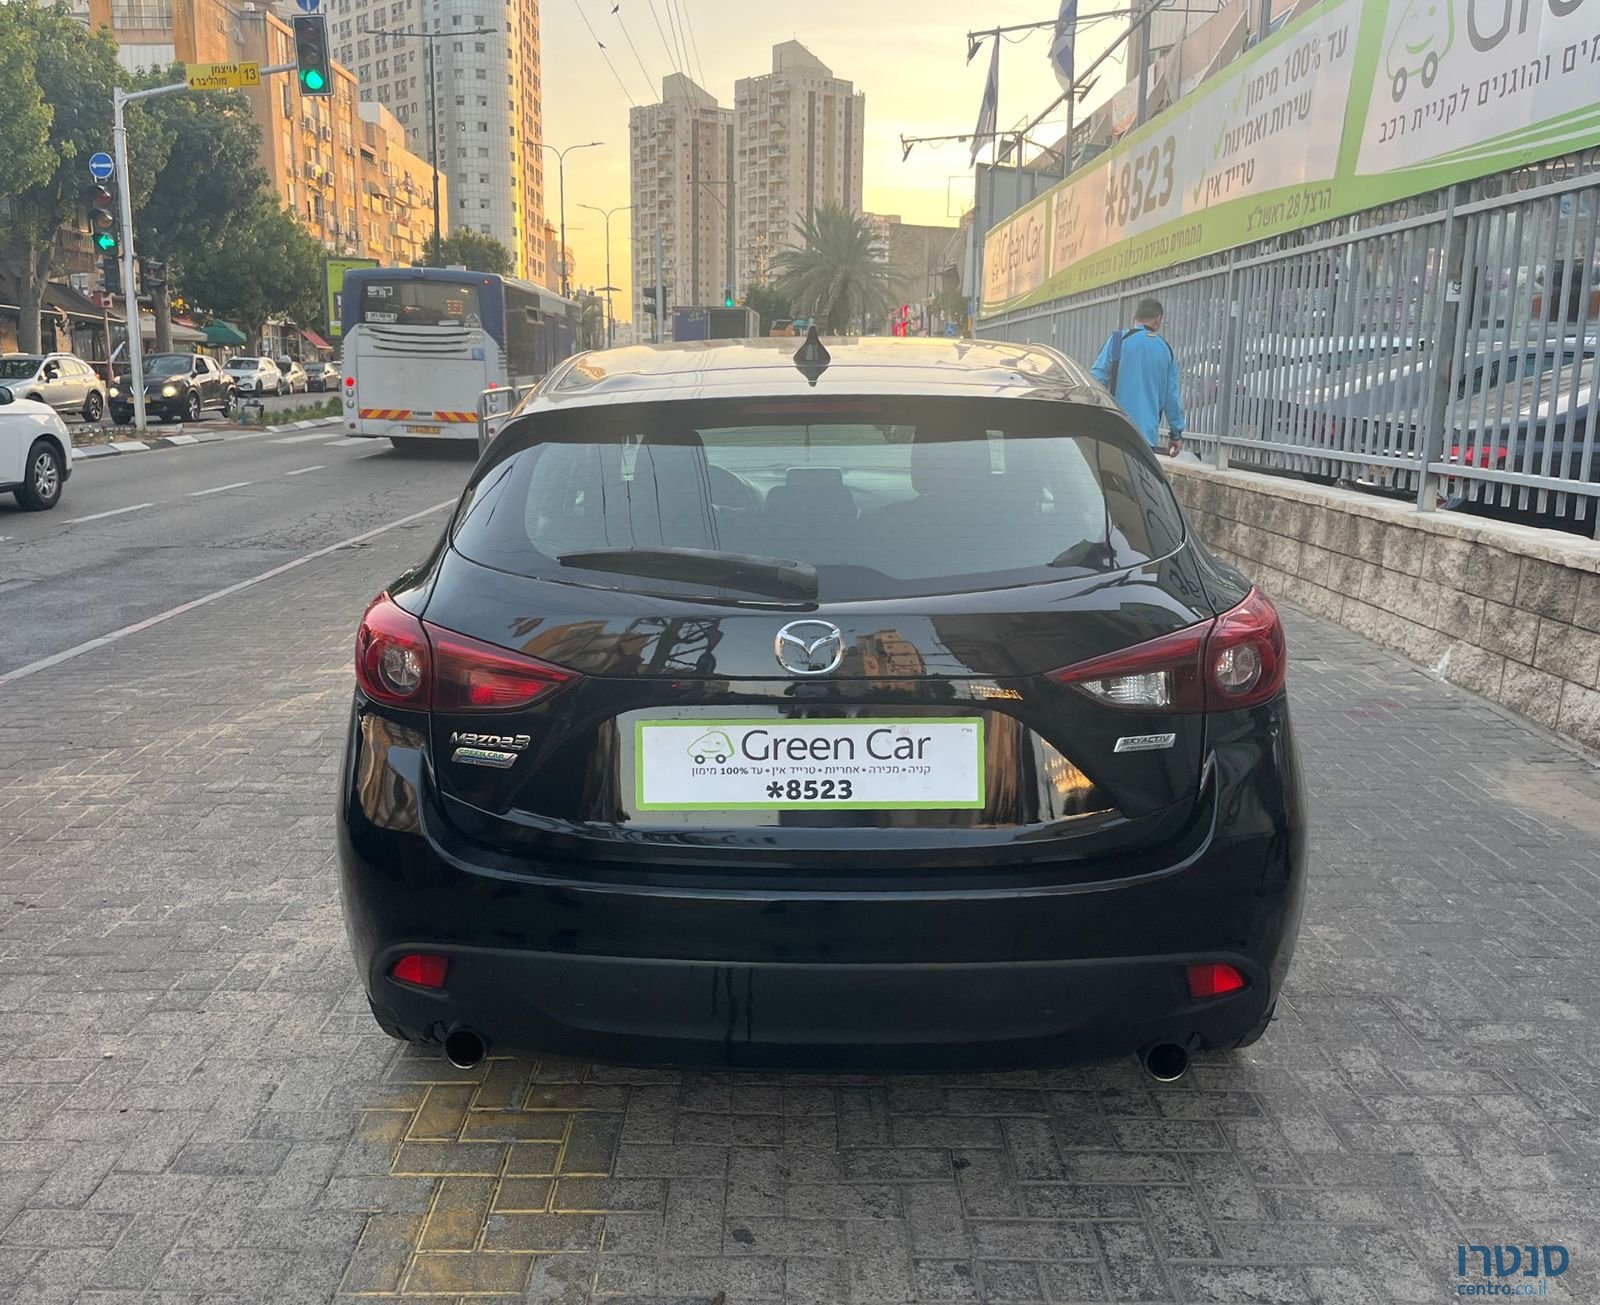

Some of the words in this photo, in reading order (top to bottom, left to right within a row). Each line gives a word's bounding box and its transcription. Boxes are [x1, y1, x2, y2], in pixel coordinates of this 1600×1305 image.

[1327, 25, 1348, 62] עד
[211, 65, 232, 76] ויצמן
[243, 68, 256, 80] 13
[1284, 38, 1321, 87] 100%
[196, 75, 228, 86] מוהליבר
[1246, 66, 1279, 116] מימון
[1477, 54, 1551, 106] והוגנים
[1270, 89, 1312, 136] שירות
[1411, 83, 1470, 132] לקניית
[1222, 113, 1267, 159] ואמינות
[1379, 114, 1406, 143] רכב
[1225, 157, 1255, 193] טרייד
[1205, 172, 1223, 208] אין
[1303, 187, 1332, 215] הרצל
[1286, 193, 1301, 221] 28
[1026, 216, 1043, 263] Car
[741, 729, 854, 761] Green
[866, 728, 931, 760] Car
[1122, 735, 1170, 745] SKYACTIV
[458, 749, 486, 758] GREEN
[487, 752, 505, 760] CAR
[691, 767, 717, 777] מימון
[720, 767, 749, 775] 100%
[750, 767, 763, 775] עד
[772, 766, 786, 777] אין
[790, 766, 816, 775] טרייד
[824, 765, 860, 774] אחריות
[868, 765, 899, 774] מכירה
[908, 765, 931, 776] קניה
